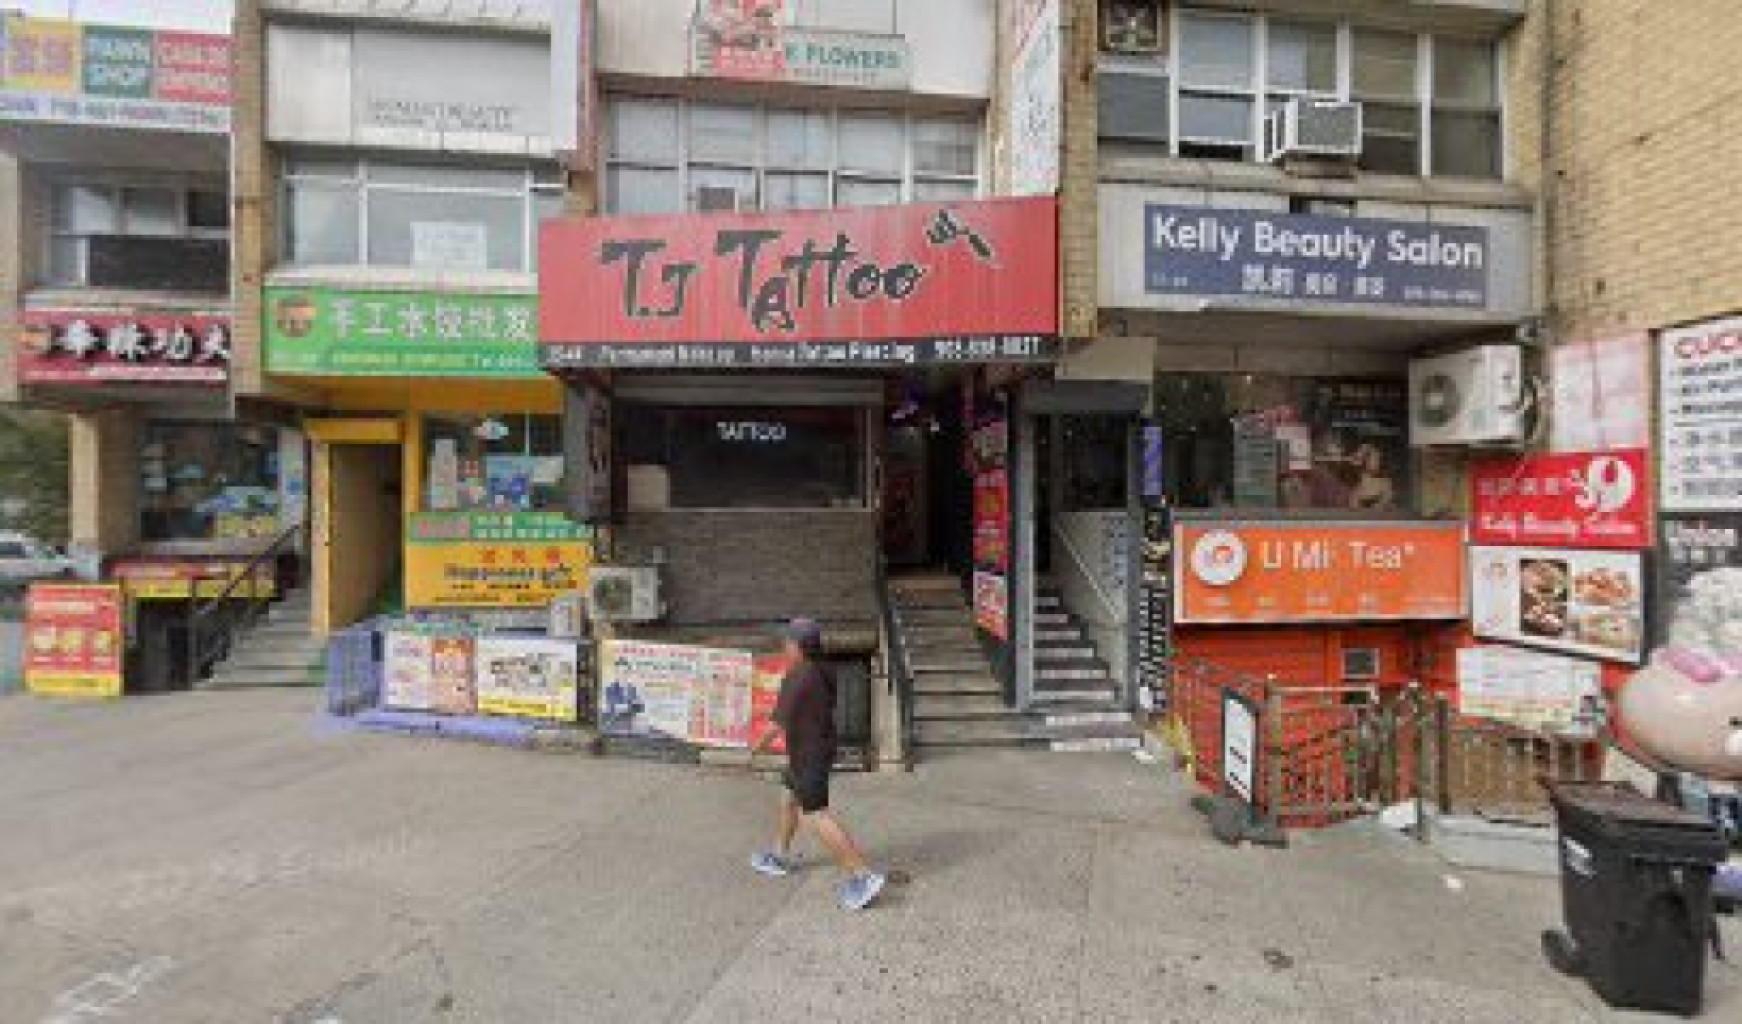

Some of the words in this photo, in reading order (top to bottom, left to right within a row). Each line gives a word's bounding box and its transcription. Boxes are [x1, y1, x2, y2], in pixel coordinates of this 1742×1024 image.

[1152, 214, 1243, 262] Kelly
[1254, 221, 1377, 270] Beauty
[1387, 230, 1485, 269] Salon
[716, 421, 787, 440] TATTOO
